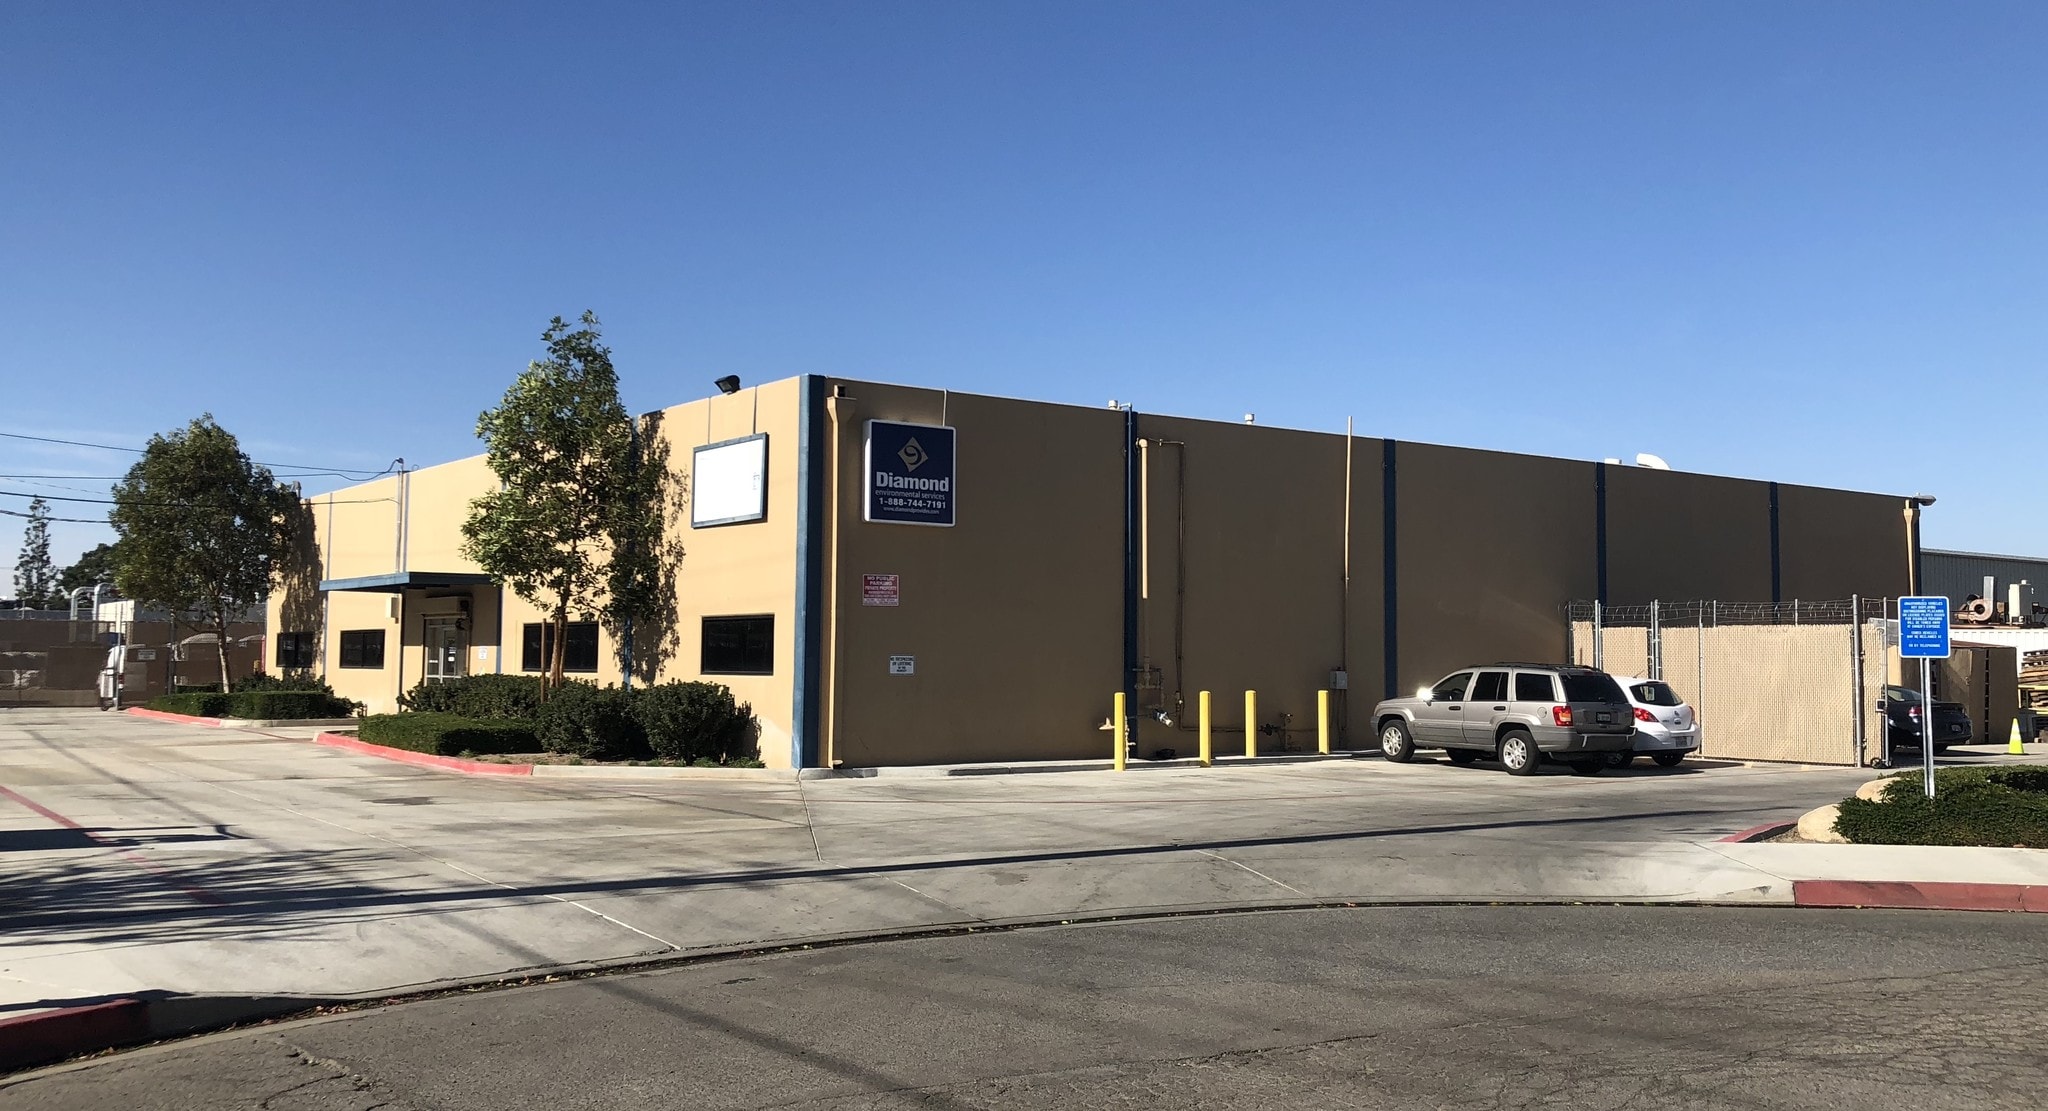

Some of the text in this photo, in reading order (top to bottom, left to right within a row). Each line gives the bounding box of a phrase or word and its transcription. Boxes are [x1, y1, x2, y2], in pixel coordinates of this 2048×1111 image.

[876, 471, 949, 492] Diamond
[875, 490, 945, 500] environmental services
[879, 497, 946, 509] 1-888-744-7191
